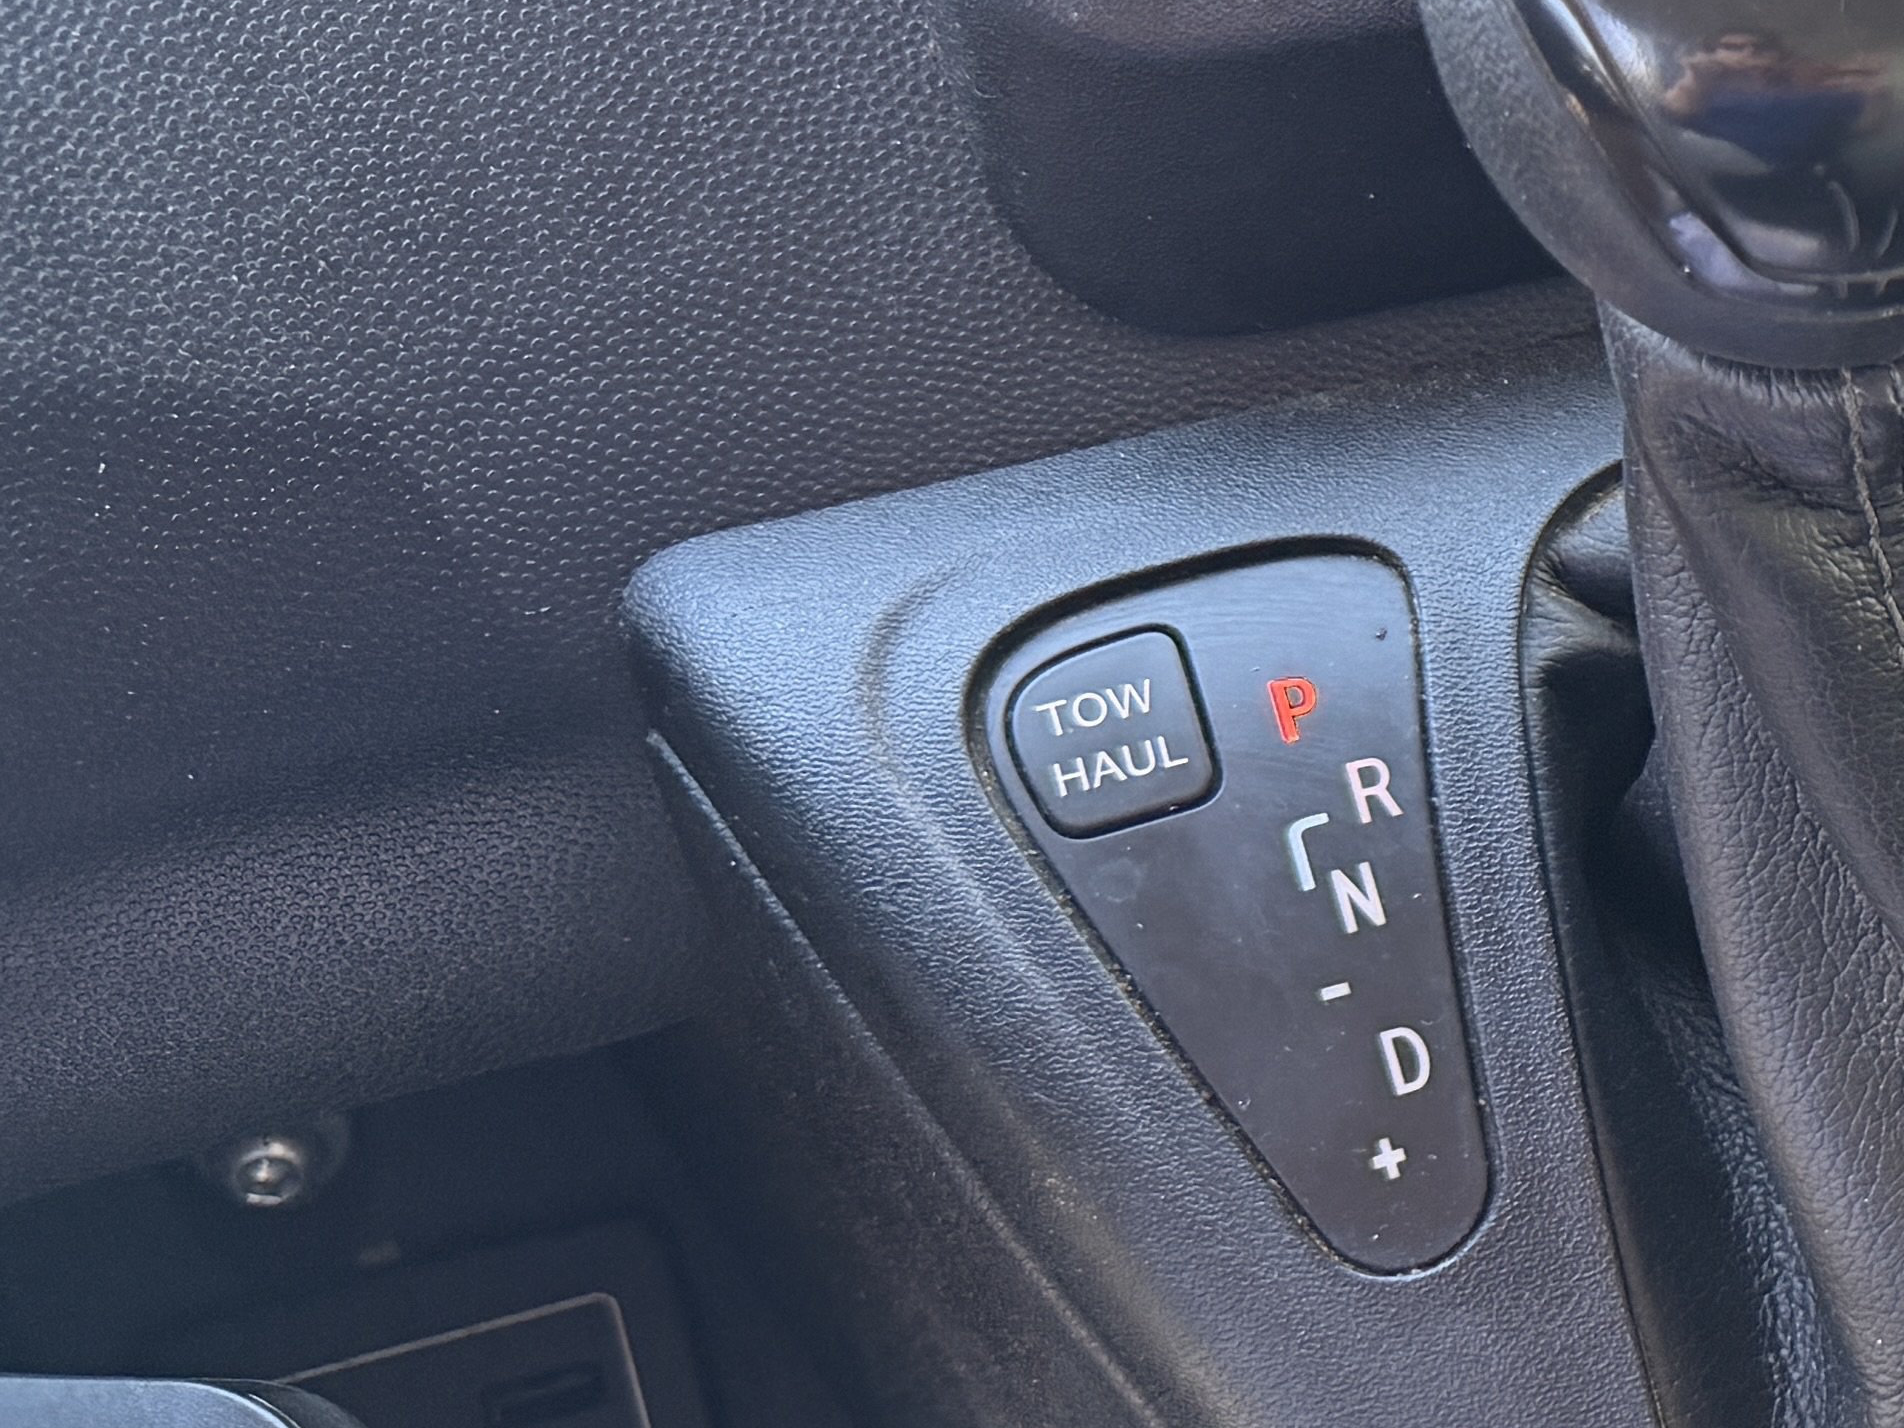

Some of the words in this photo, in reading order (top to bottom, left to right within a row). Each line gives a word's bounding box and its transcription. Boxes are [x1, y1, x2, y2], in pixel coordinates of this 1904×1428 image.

[1034, 678, 1152, 739] TOW
[1267, 676, 1318, 744] P
[1053, 733, 1189, 799] HAUL
[1346, 757, 1404, 824] R
[1330, 861, 1388, 935] N
[1379, 1026, 1432, 1097] D
